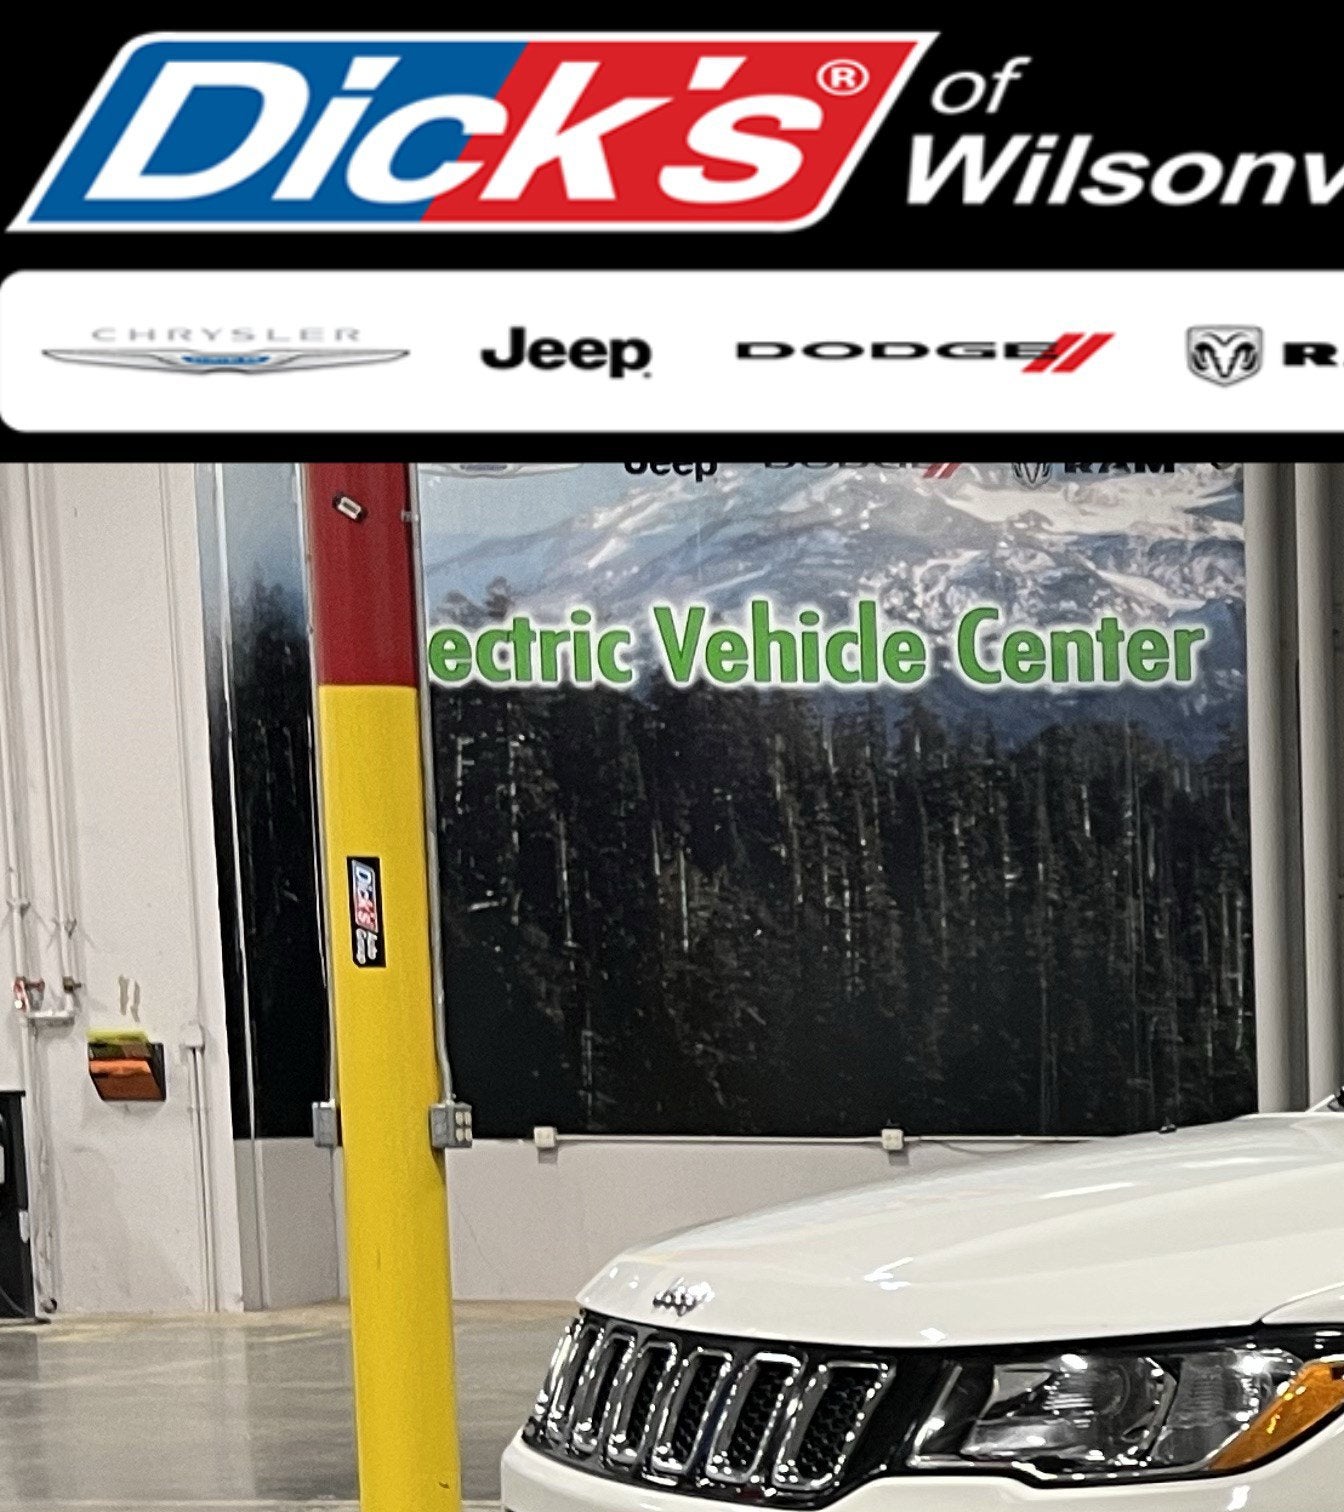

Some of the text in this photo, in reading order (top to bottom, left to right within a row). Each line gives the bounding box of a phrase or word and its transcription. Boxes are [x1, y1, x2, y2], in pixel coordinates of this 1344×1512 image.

[428, 599, 1207, 685] ectric Vehicle Center
